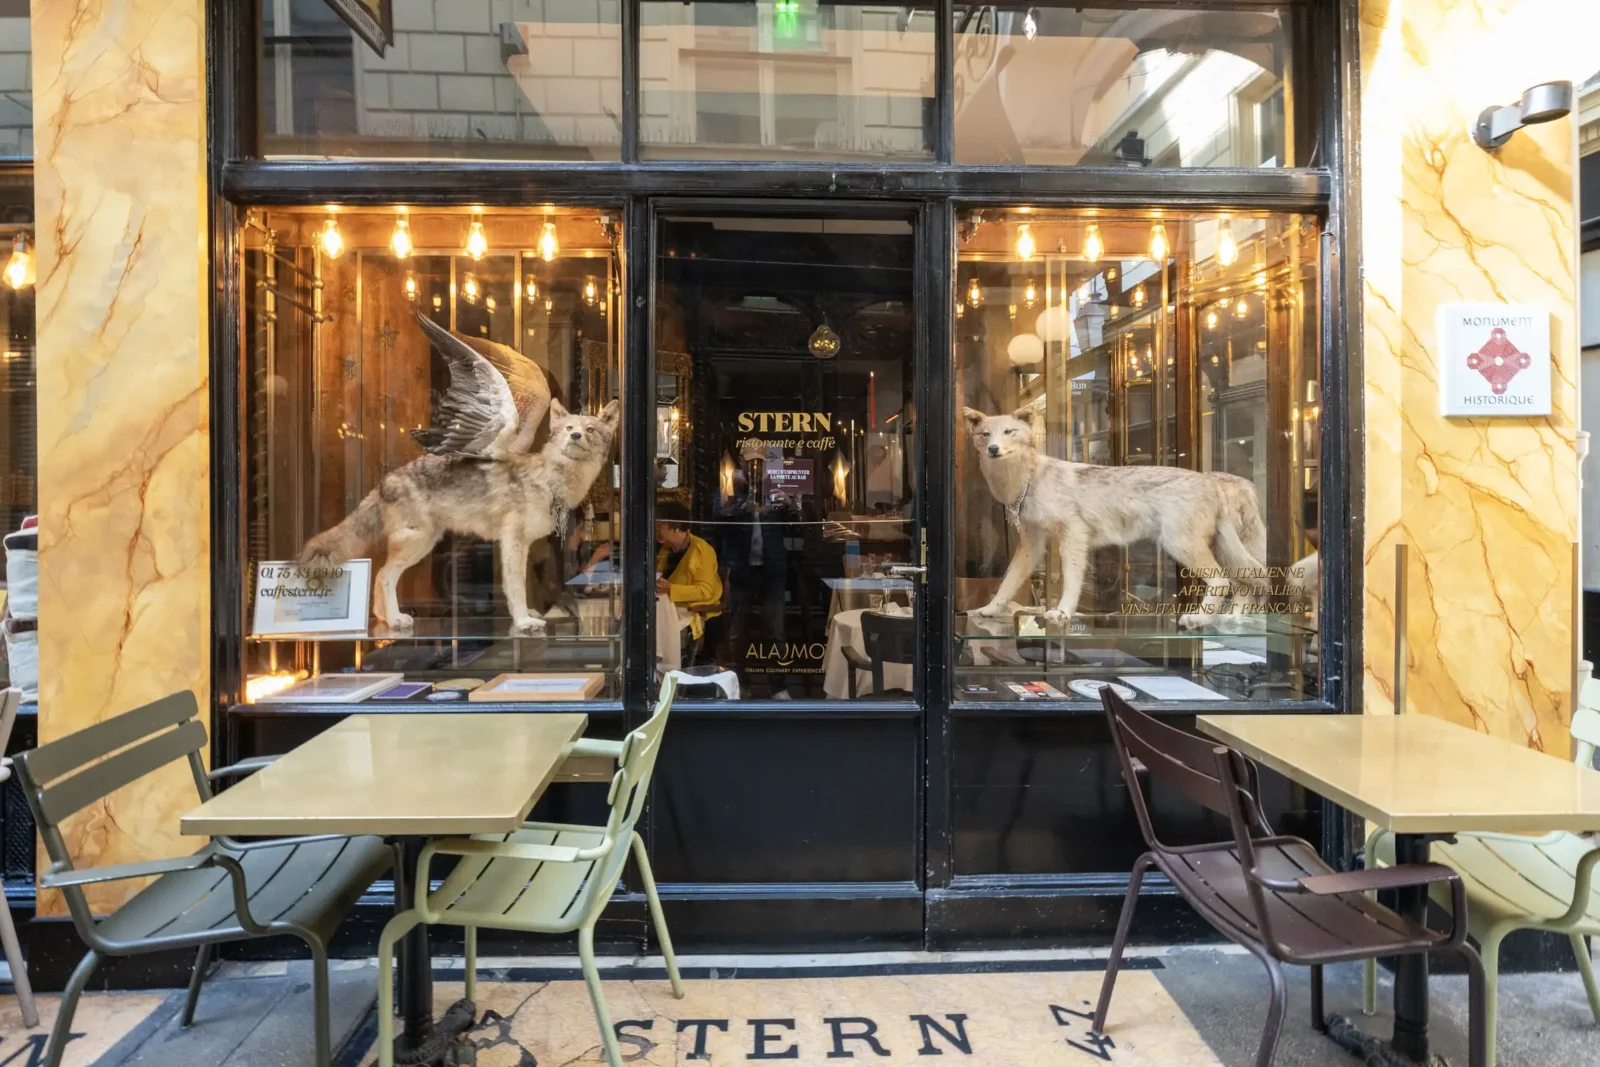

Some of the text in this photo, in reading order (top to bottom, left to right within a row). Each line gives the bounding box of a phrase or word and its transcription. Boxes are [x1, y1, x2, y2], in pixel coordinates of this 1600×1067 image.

[1463, 317, 1532, 326] MONUMENT
[1464, 395, 1534, 405] HISTORIQUE
[738, 412, 832, 432] STERN
[736, 436, 836, 451] ristorante e caffè
[261, 567, 274, 579] 01
[277, 567, 291, 579] 75
[1180, 567, 1305, 578] CUISINE ITALIENNE
[1178, 585, 1306, 596] APERITIVO ITALIEN
[1120, 603, 1305, 616] VINS ITALIENS ET FRANÇAIS
[612, 1013, 972, 1062] STERN
